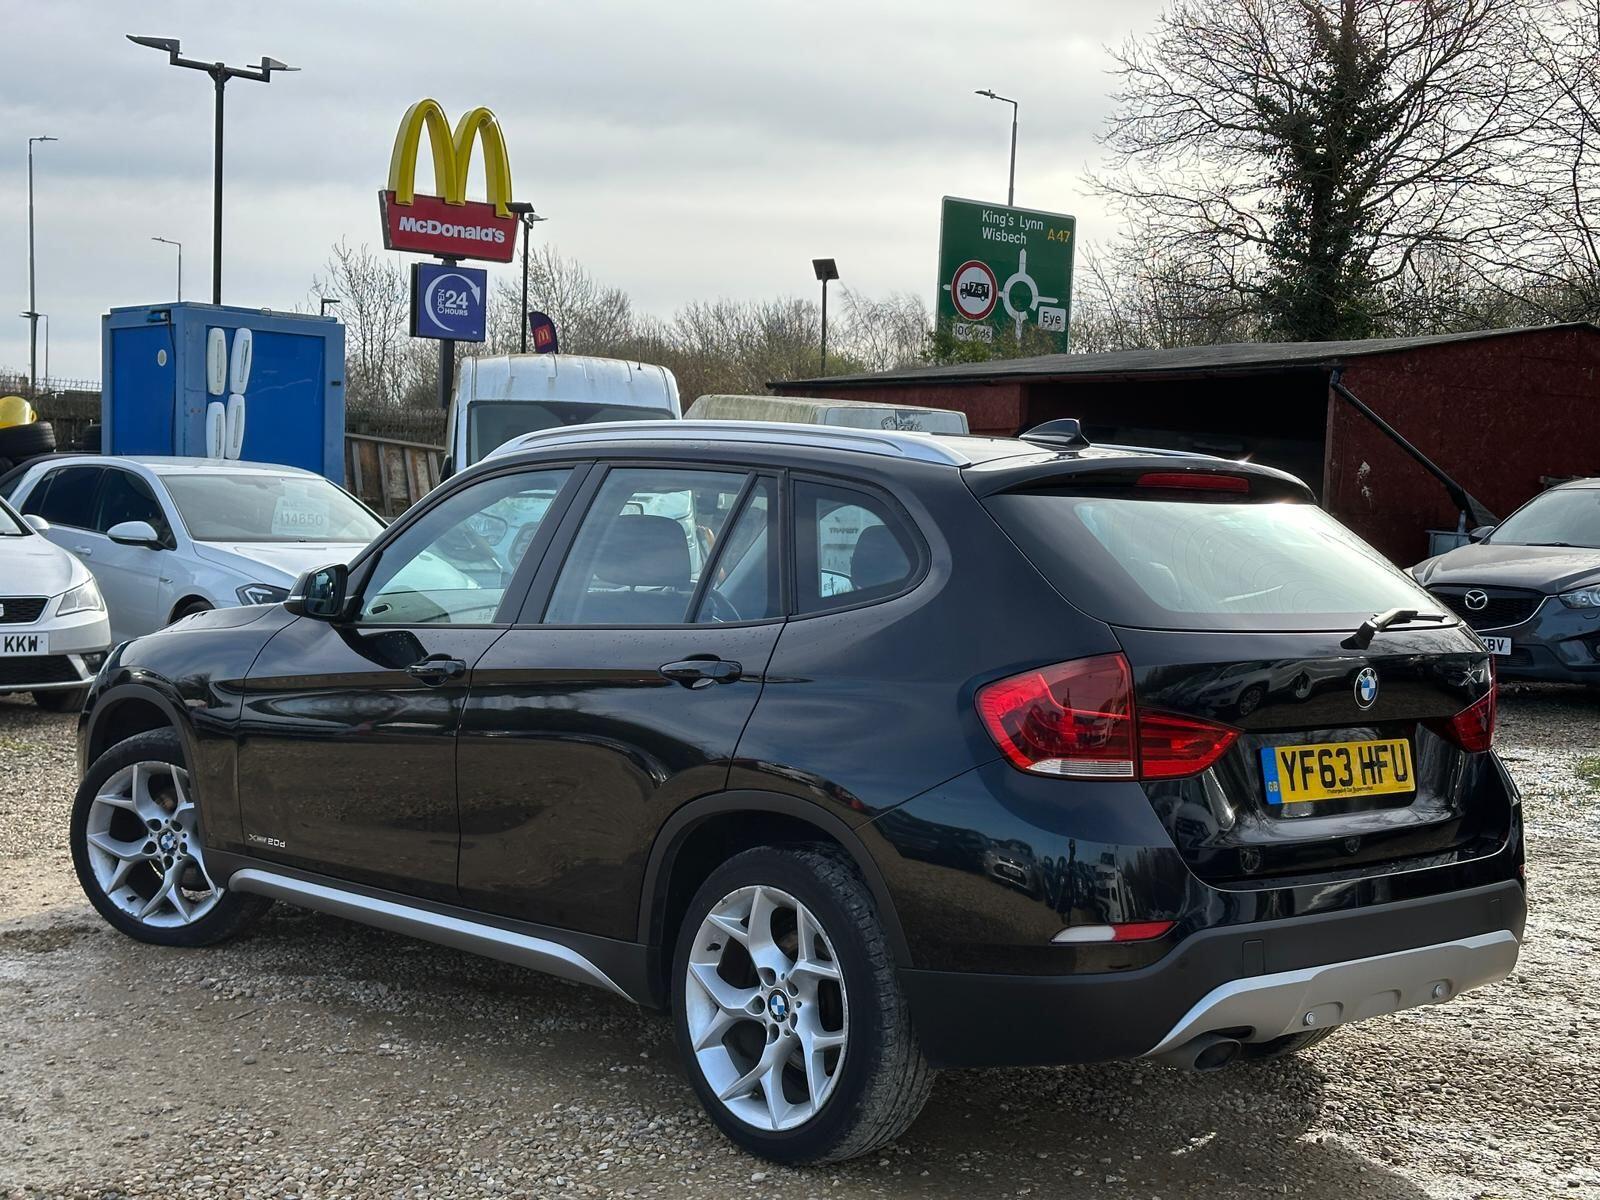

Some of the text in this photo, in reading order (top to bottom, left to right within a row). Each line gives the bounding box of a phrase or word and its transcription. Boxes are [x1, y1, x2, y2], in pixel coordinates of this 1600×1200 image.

[982, 209, 1044, 231] King's Lynn
[398, 216, 505, 243] McDonald's
[982, 227, 1027, 245] Wisbech
[437, 288, 445, 314] OPEN
[444, 290, 469, 309] 24
[444, 308, 468, 317] HOURS
[1042, 311, 1061, 326] Eye
[4, 635, 38, 653] KKW
[1484, 638, 1504, 652] BV
[1281, 743, 1408, 791] YF63 HFU
[1268, 781, 1280, 792] GB
